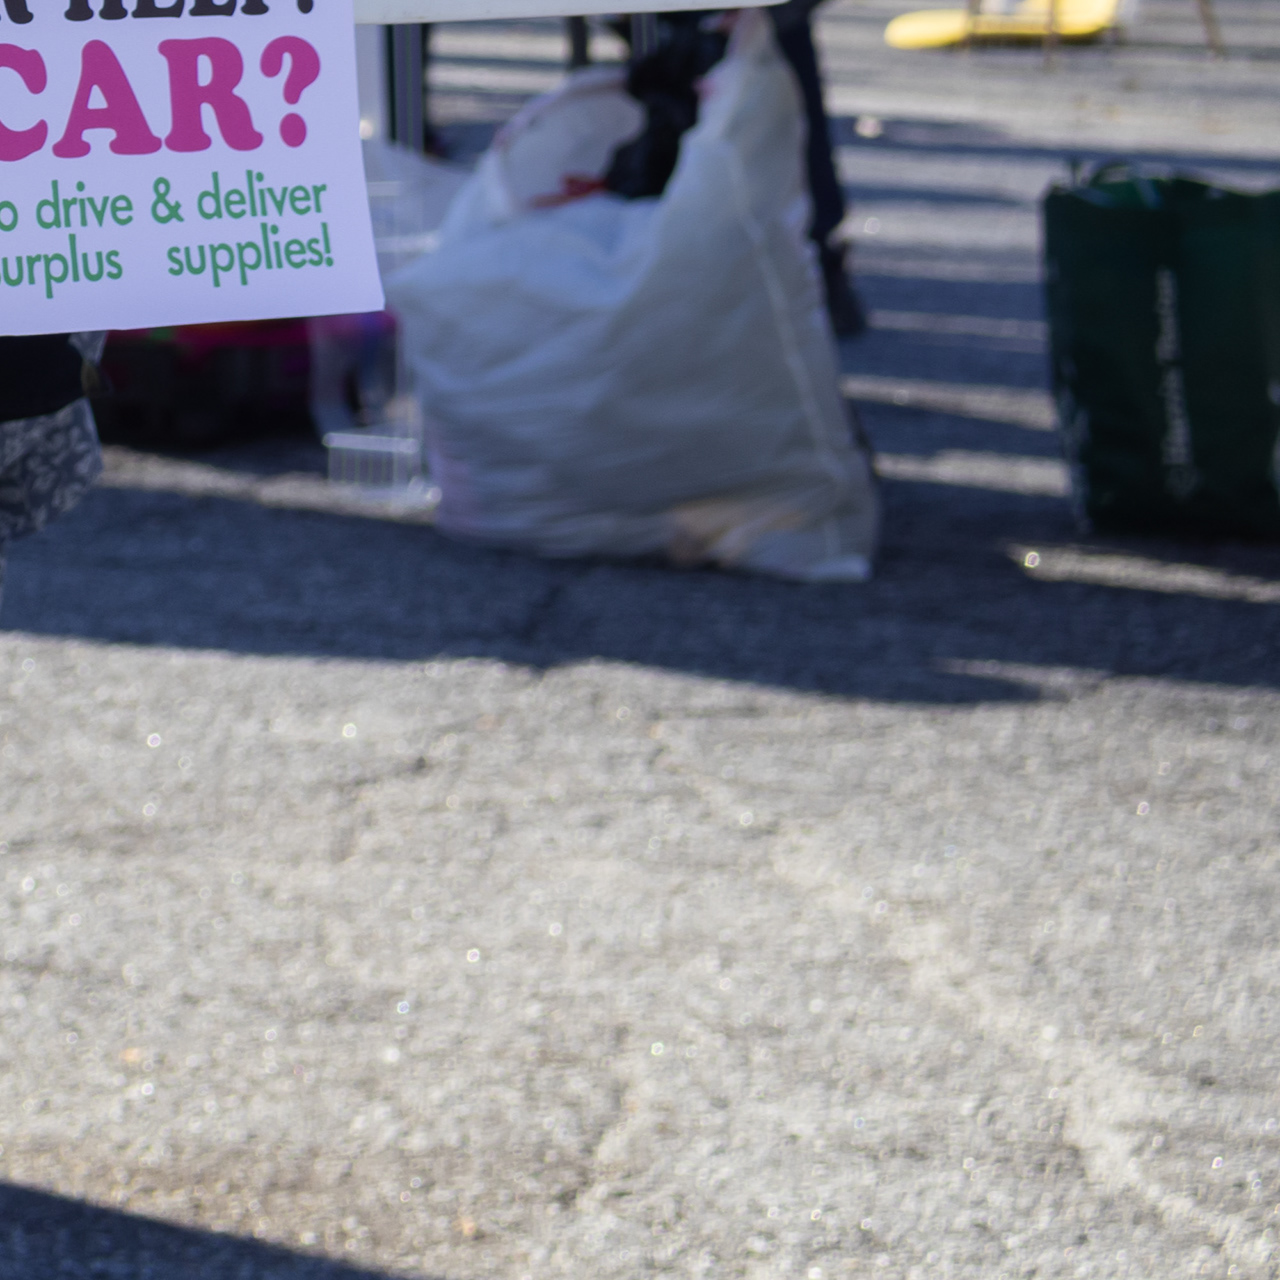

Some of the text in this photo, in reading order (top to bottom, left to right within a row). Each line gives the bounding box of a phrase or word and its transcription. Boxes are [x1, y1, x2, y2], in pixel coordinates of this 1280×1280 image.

[36, 178, 133, 229] drive
[151, 176, 185, 224] &
[197, 169, 327, 220] deliver
[167, 222, 334, 287] supplies!
